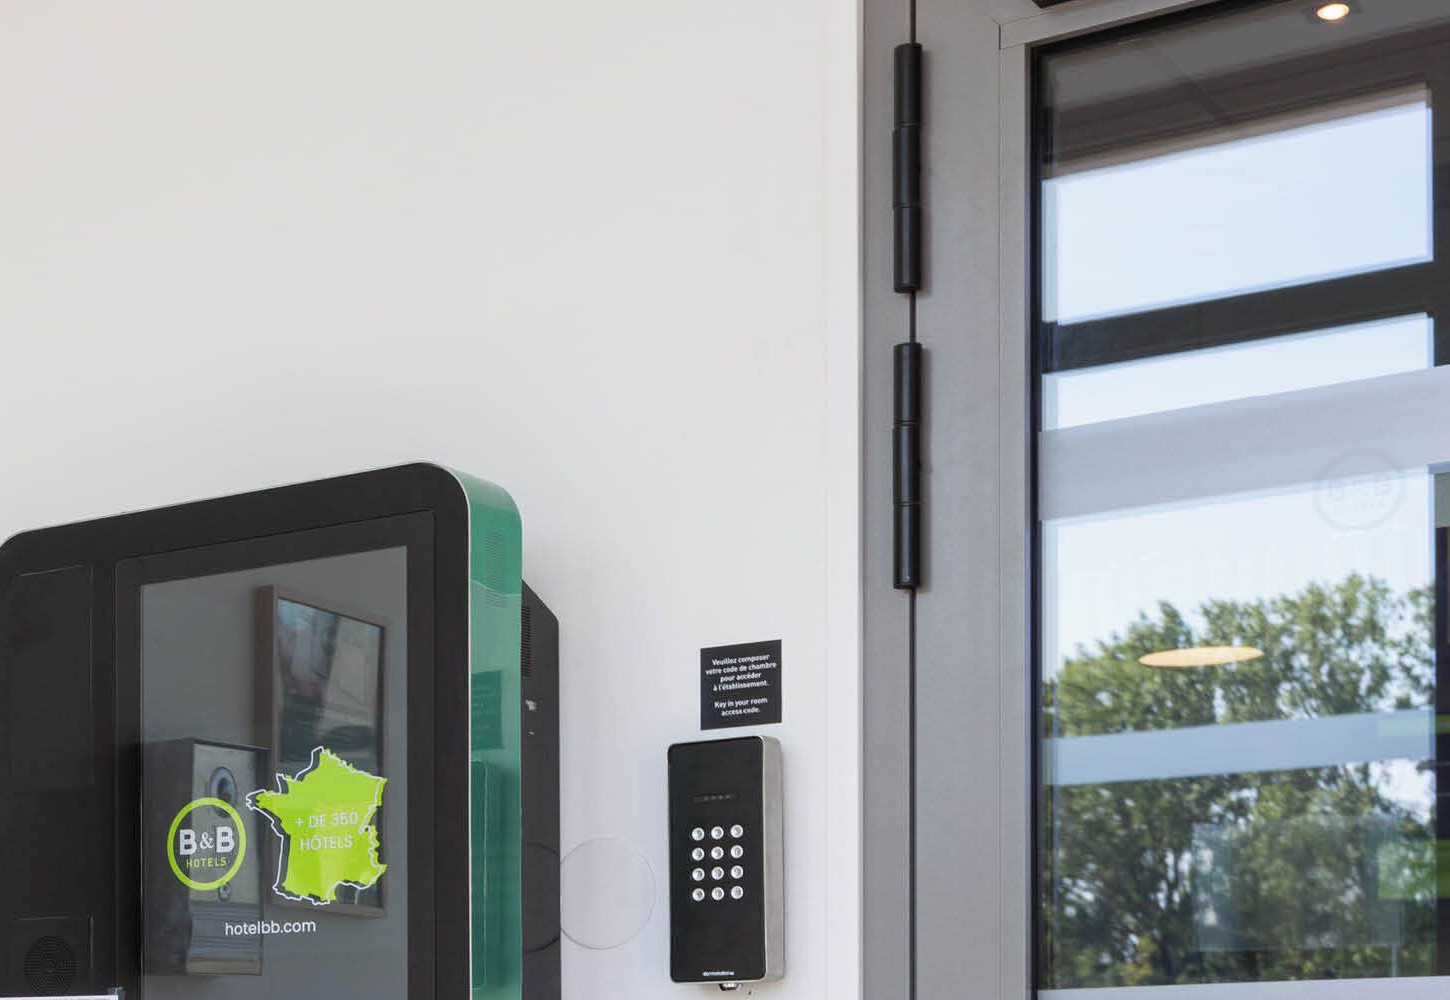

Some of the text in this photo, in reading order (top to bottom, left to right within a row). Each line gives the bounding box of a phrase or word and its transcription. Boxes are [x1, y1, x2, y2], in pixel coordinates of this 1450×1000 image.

[712, 654, 770, 666] Veuillez composer
[705, 662, 777, 676] votre code de chambre
[720, 672, 762, 683] pour accéder
[714, 701, 727, 709] Key
[727, 699, 734, 707] in
[735, 699, 749, 708] your
[721, 708, 742, 716] access
[308, 814, 327, 829] DE
[331, 811, 358, 827] 350
[179, 826, 235, 856] B&B
[300, 834, 353, 851] HÔTELS
[186, 856, 227, 869] HOTELS
[225, 920, 317, 936] hotelbb.com
